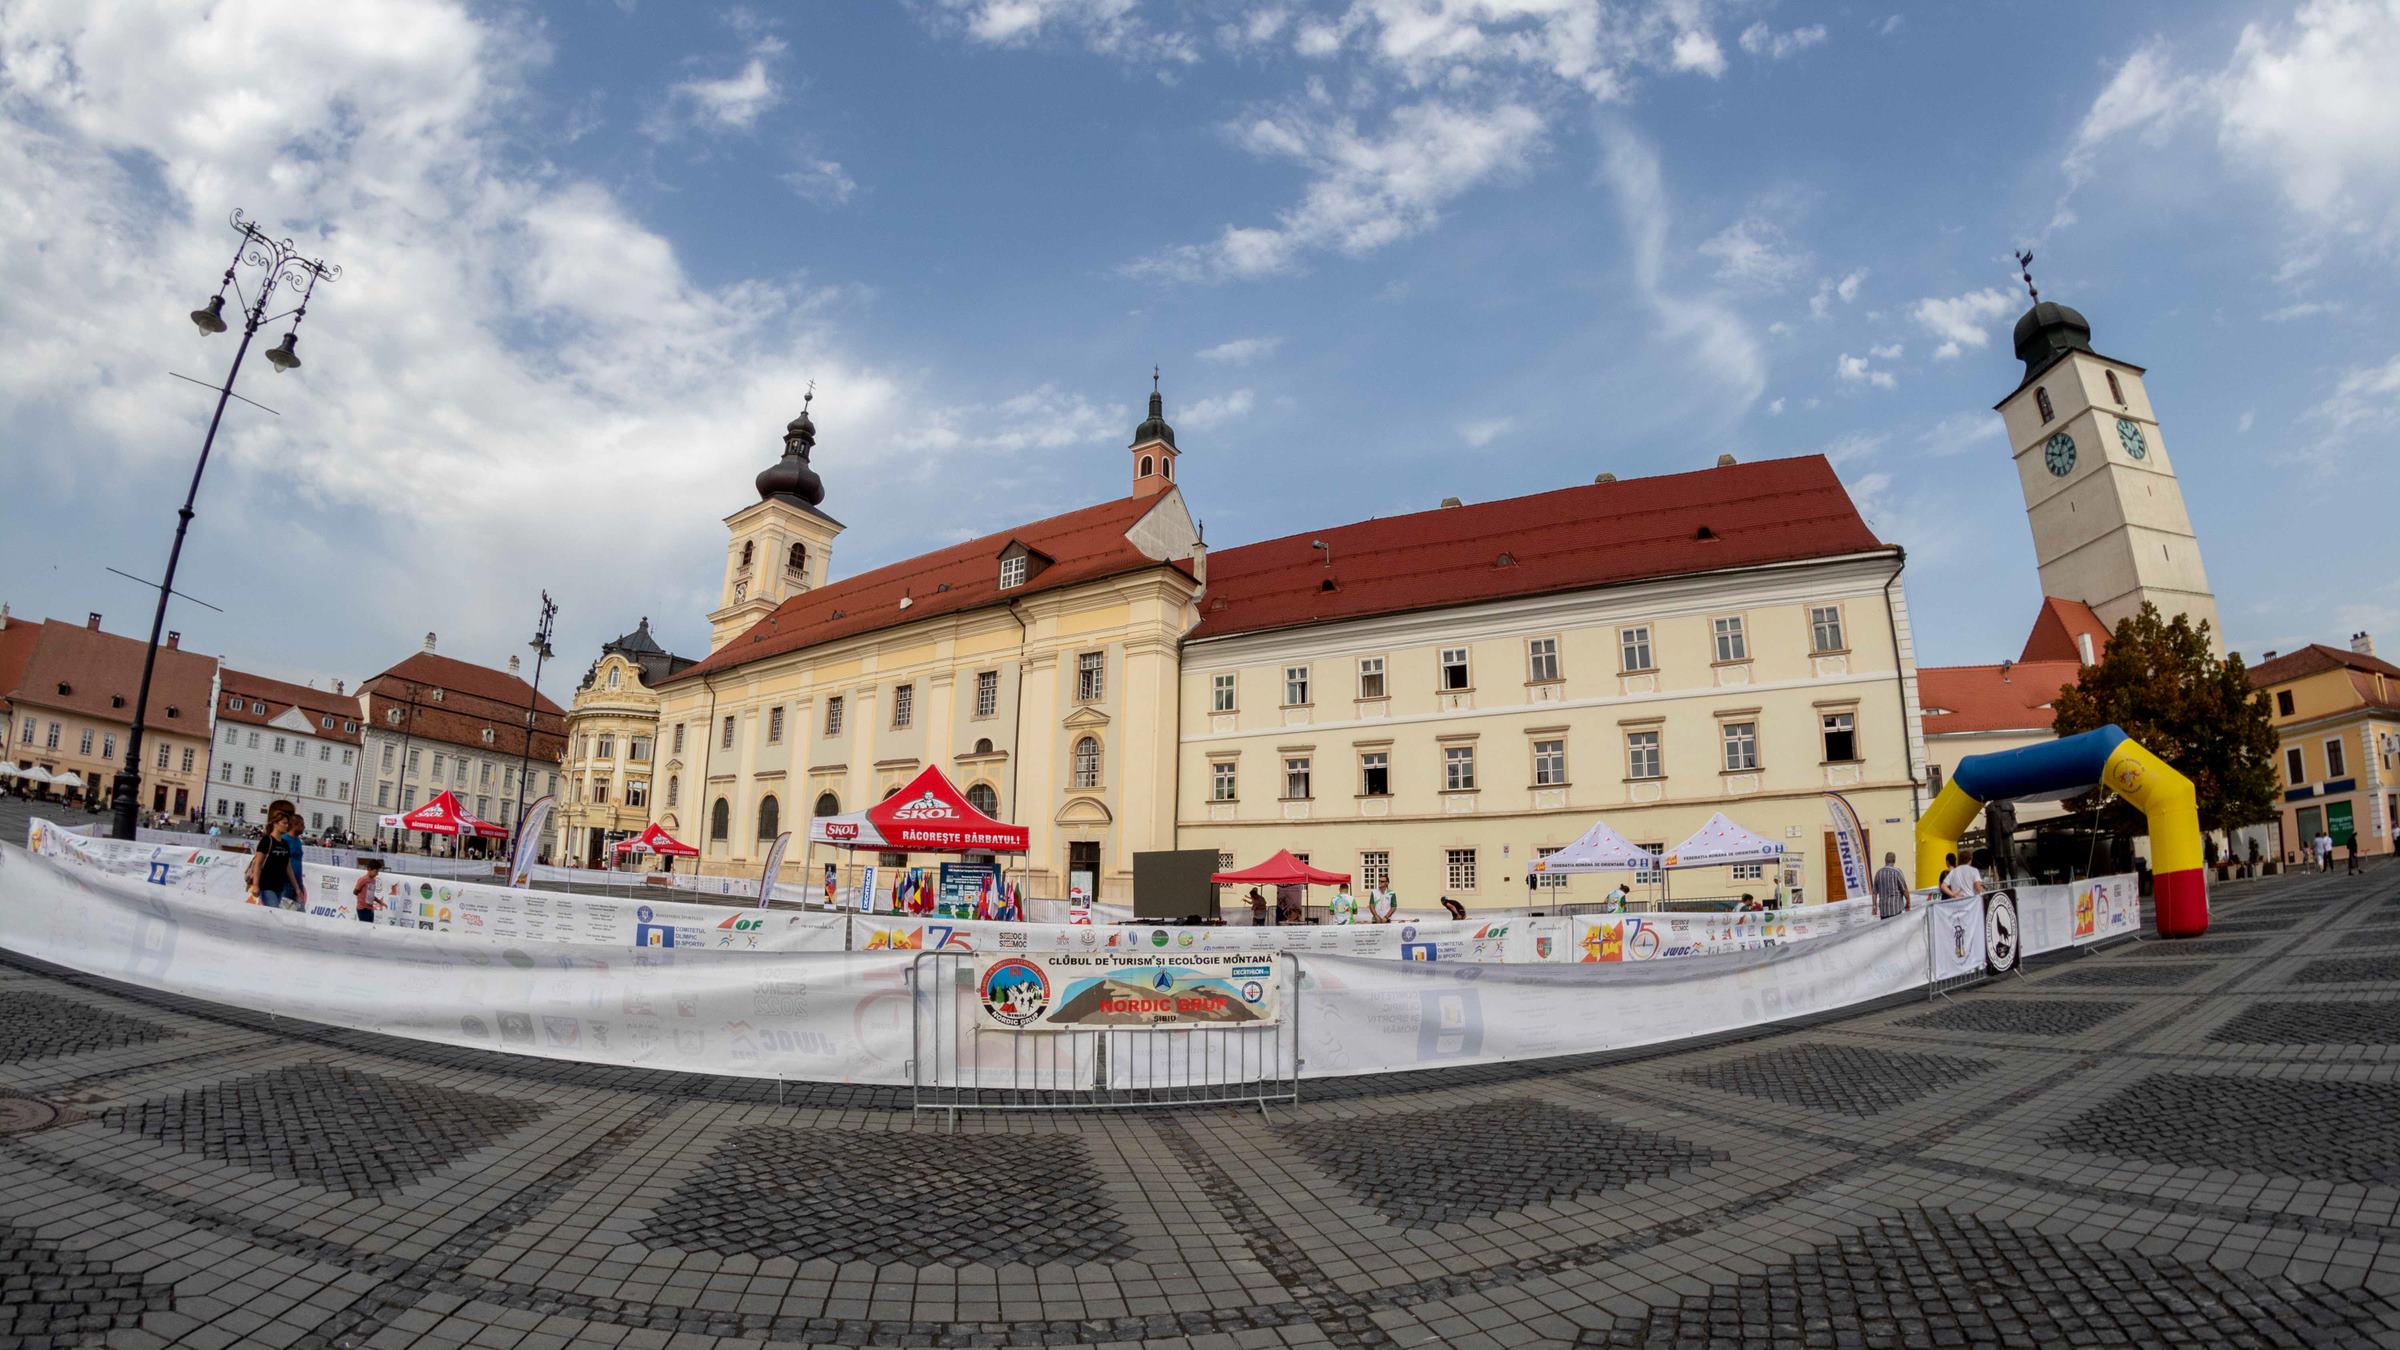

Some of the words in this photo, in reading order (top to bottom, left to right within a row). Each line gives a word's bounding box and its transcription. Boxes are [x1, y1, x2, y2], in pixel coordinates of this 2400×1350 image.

[893, 809, 960, 820] SKOL
[827, 825, 857, 836] SKOL
[964, 832, 1020, 844] BĂRBATUL!
[1837, 831, 1859, 890] FINISH
[311, 905, 336, 918] JWOC
[1663, 946, 1690, 956] JWOC
[1169, 956, 1220, 965] ECOLOGIE
[1223, 954, 1272, 964] MONTANĂ
[1100, 998, 1172, 1013] NORDIC
[1177, 996, 1227, 1012] GRUP
[992, 1012, 1018, 1026] NORDIC
[1020, 1012, 1039, 1024] GRUP
